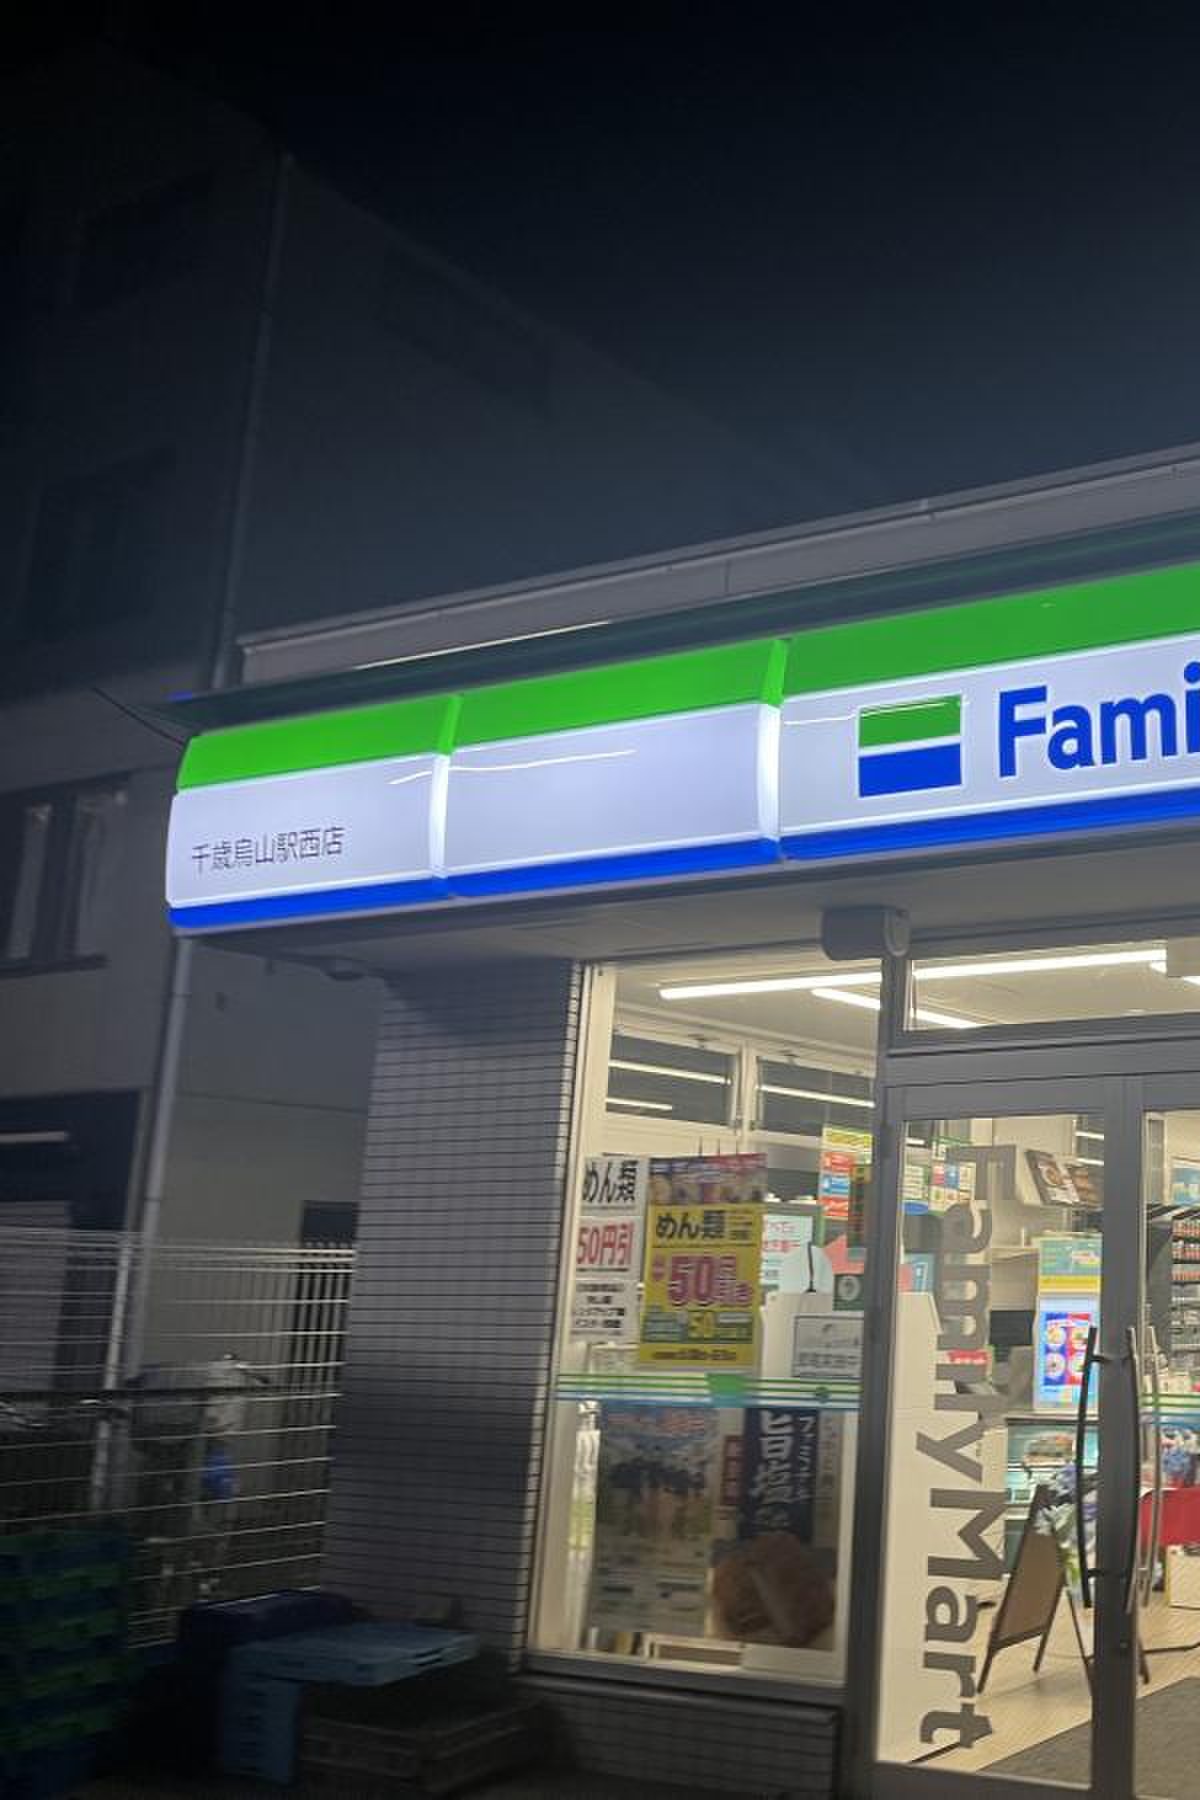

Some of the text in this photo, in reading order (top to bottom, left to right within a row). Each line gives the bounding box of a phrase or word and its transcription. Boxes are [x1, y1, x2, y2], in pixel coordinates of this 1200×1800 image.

[191, 826, 346, 874] 千歳烏山駅西店
